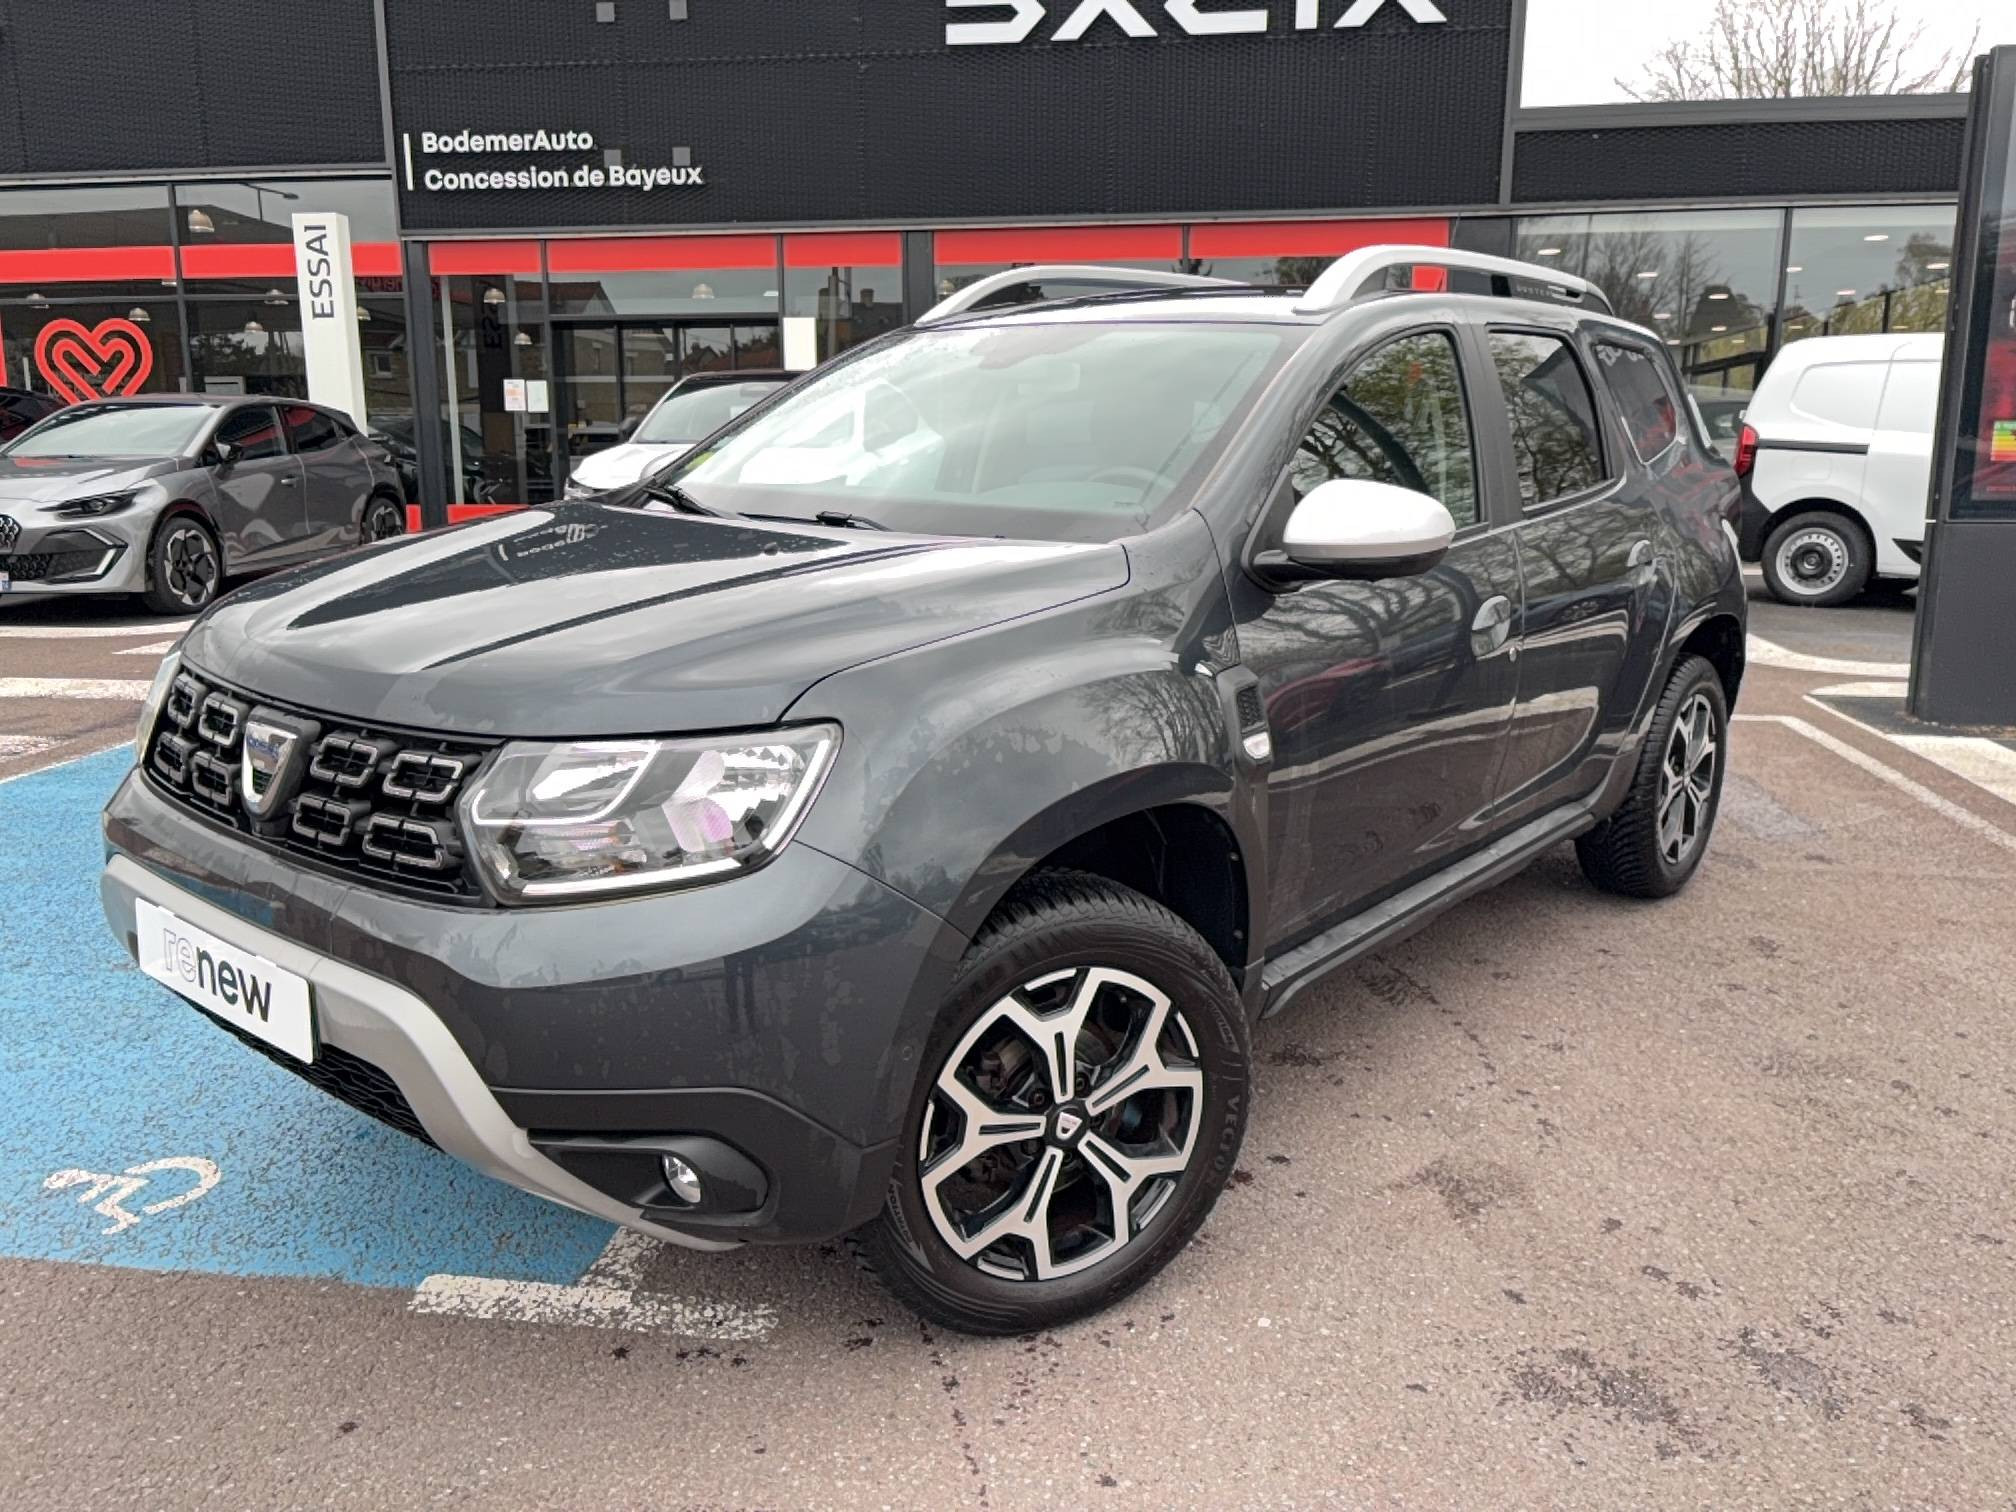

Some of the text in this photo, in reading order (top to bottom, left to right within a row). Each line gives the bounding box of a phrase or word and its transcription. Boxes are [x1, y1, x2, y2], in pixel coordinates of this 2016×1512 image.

[421, 129, 593, 153] BodemerAuto
[425, 165, 702, 191] Concession de Bayeux
[304, 225, 334, 320] ESSAI
[163, 927, 272, 1023] renew
